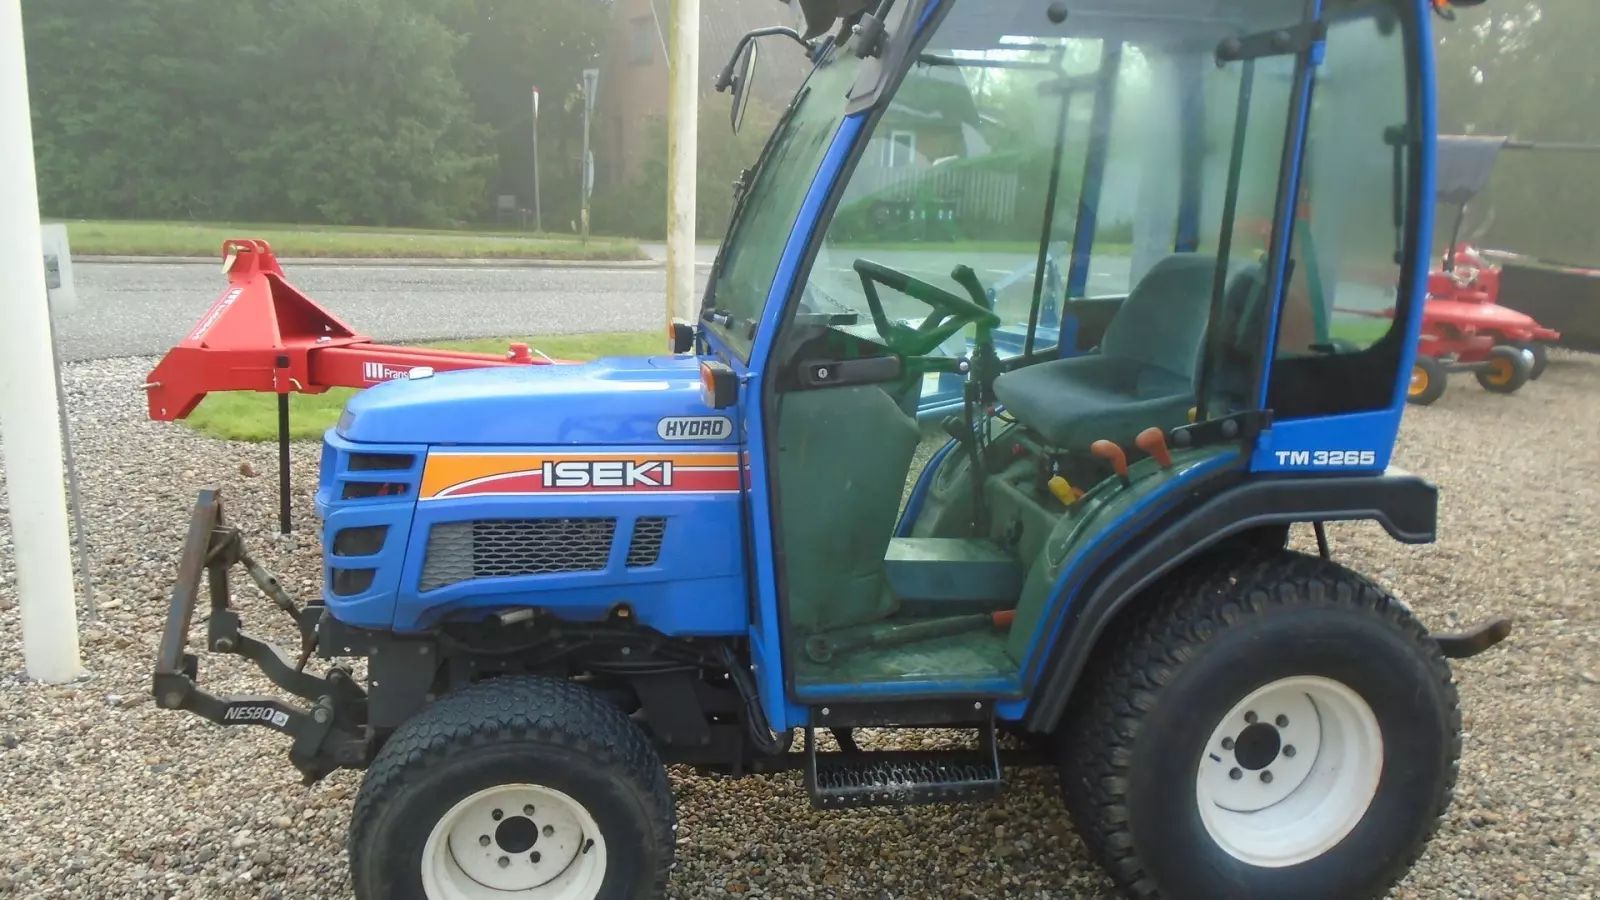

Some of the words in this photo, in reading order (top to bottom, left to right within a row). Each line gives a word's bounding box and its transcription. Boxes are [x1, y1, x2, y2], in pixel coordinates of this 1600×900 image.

[665, 420, 724, 436] HYDRO
[1275, 450, 1310, 465] TM
[1313, 450, 1376, 465] 3265
[542, 460, 673, 488] ISEKI
[224, 706, 275, 720] NESBO
